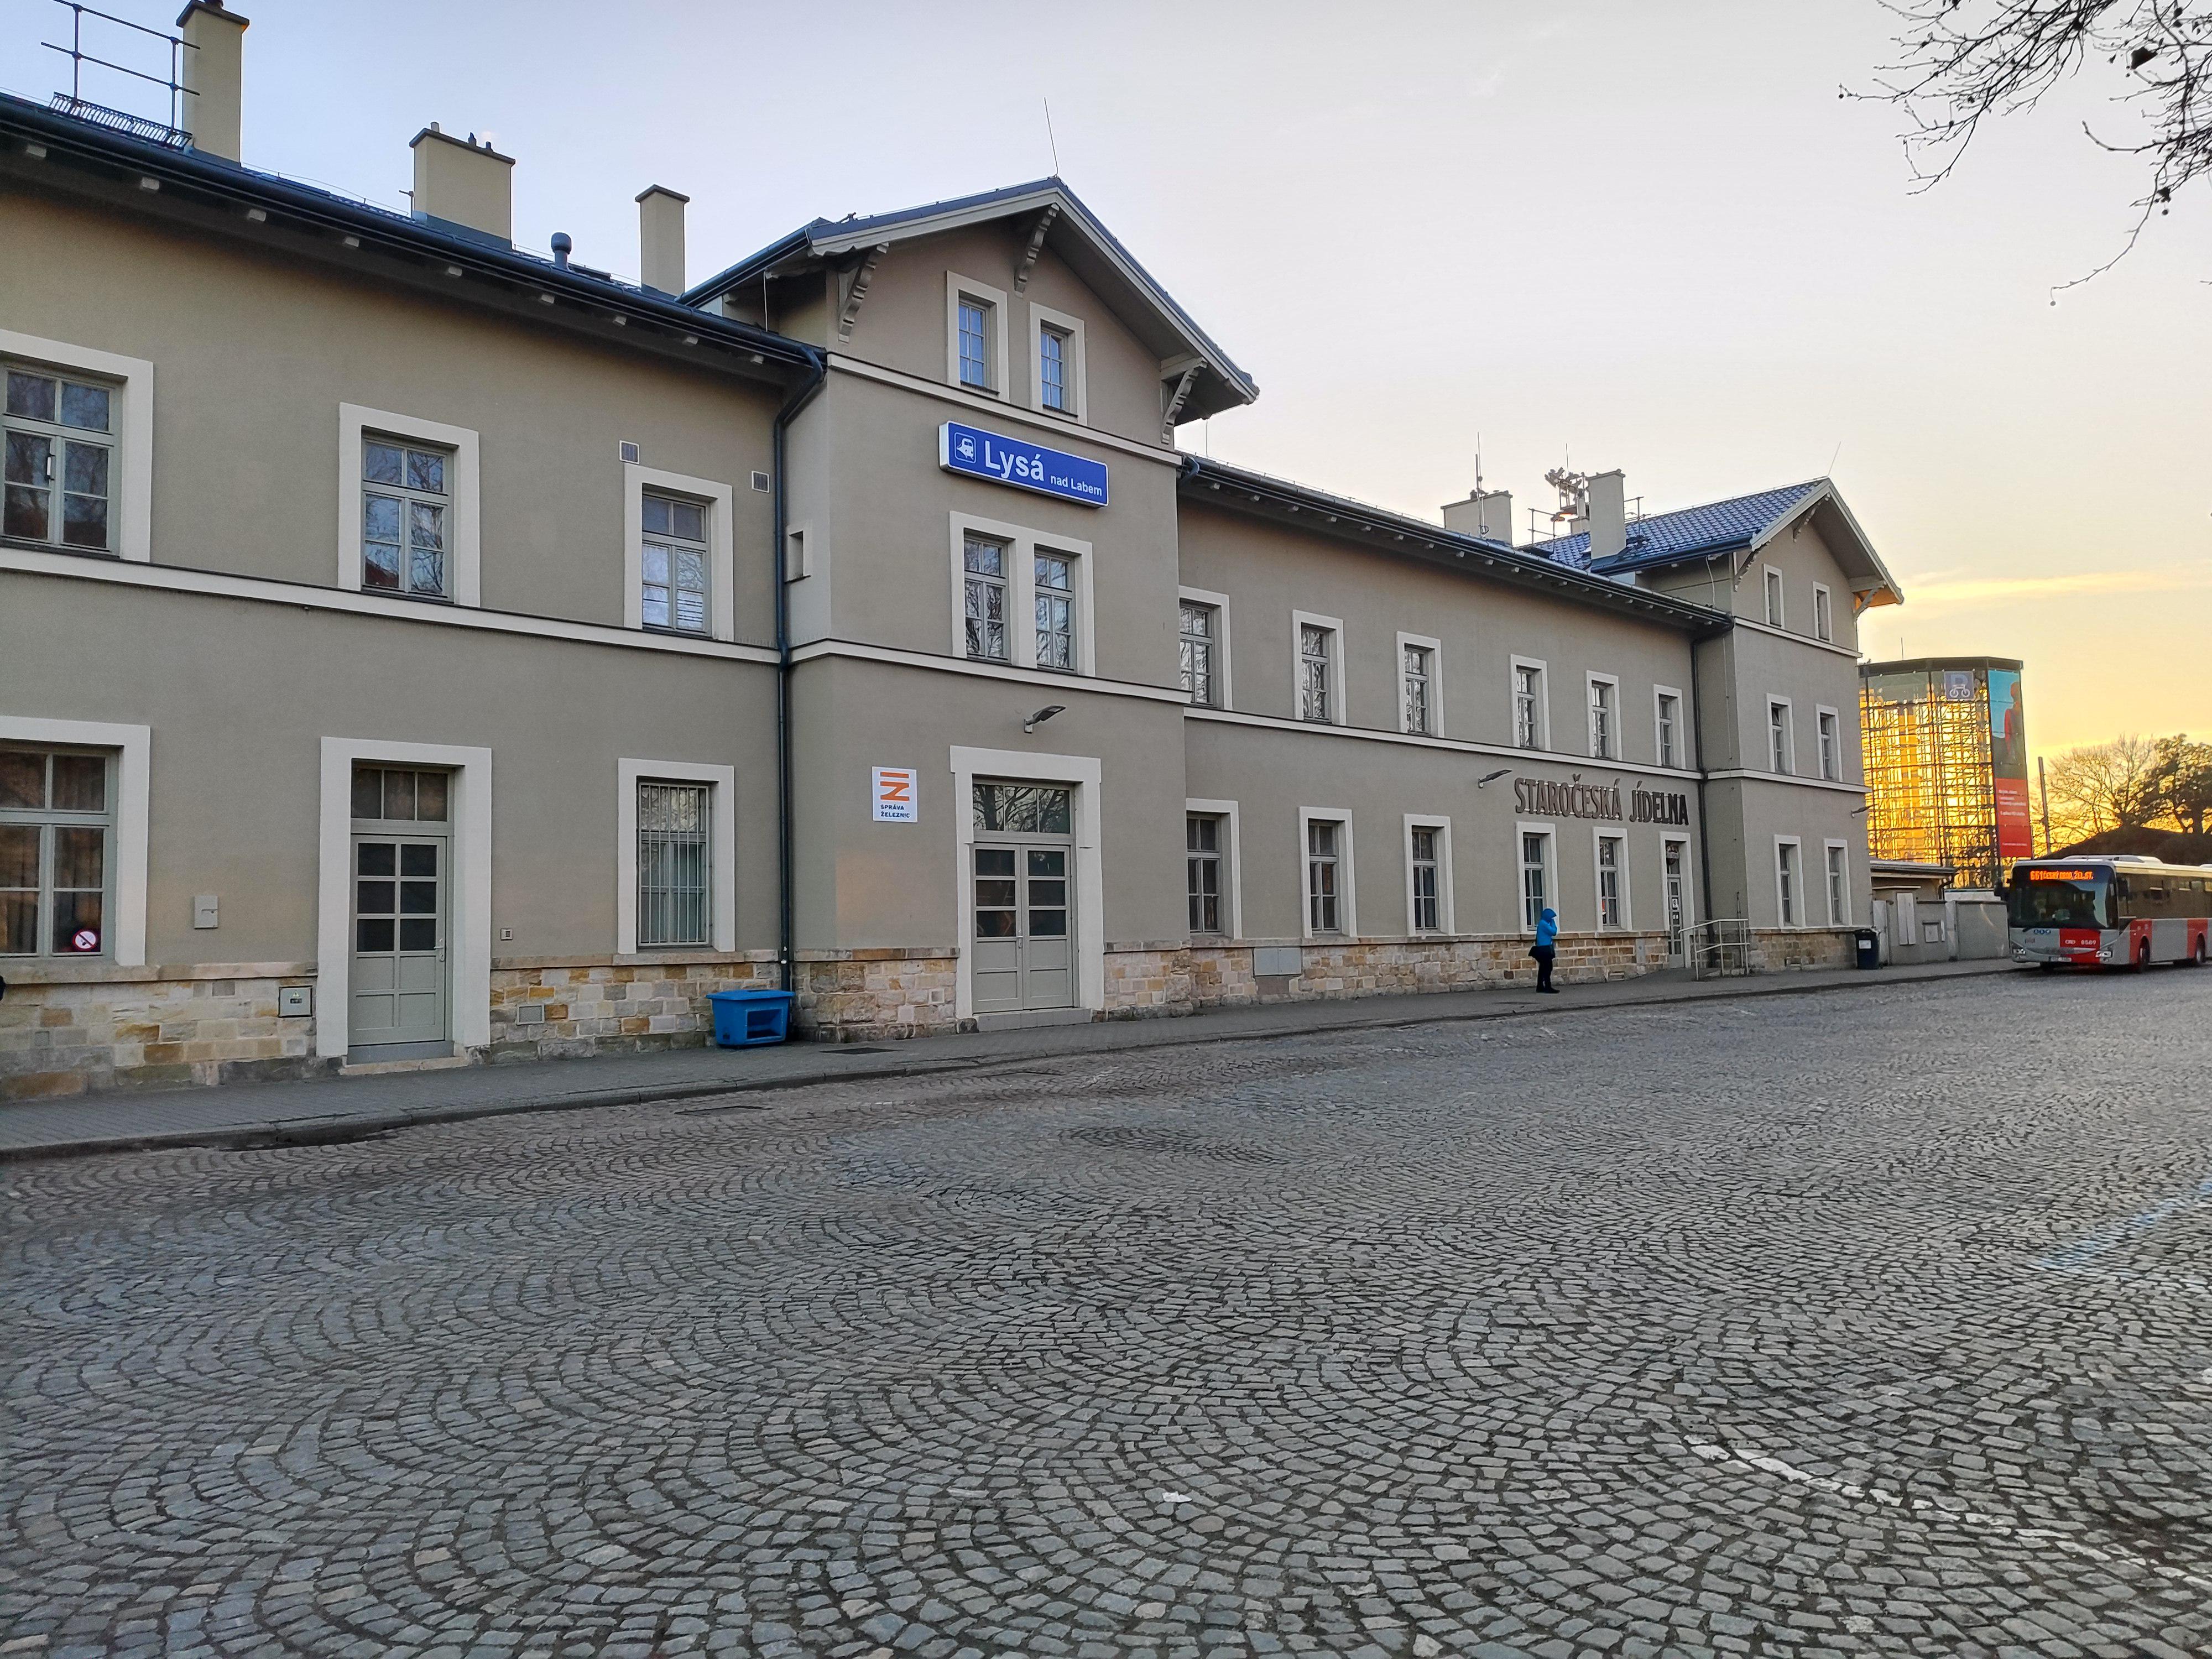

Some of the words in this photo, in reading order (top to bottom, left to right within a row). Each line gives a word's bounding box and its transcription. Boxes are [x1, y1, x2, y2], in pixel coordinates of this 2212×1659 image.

[984, 440, 1045, 482] Lysá
[1050, 474, 1068, 488] nad
[1071, 478, 1102, 497] Labem
[1514, 773, 1623, 821] STAROČESKÁ
[1629, 780, 1689, 825] JÍDELNA
